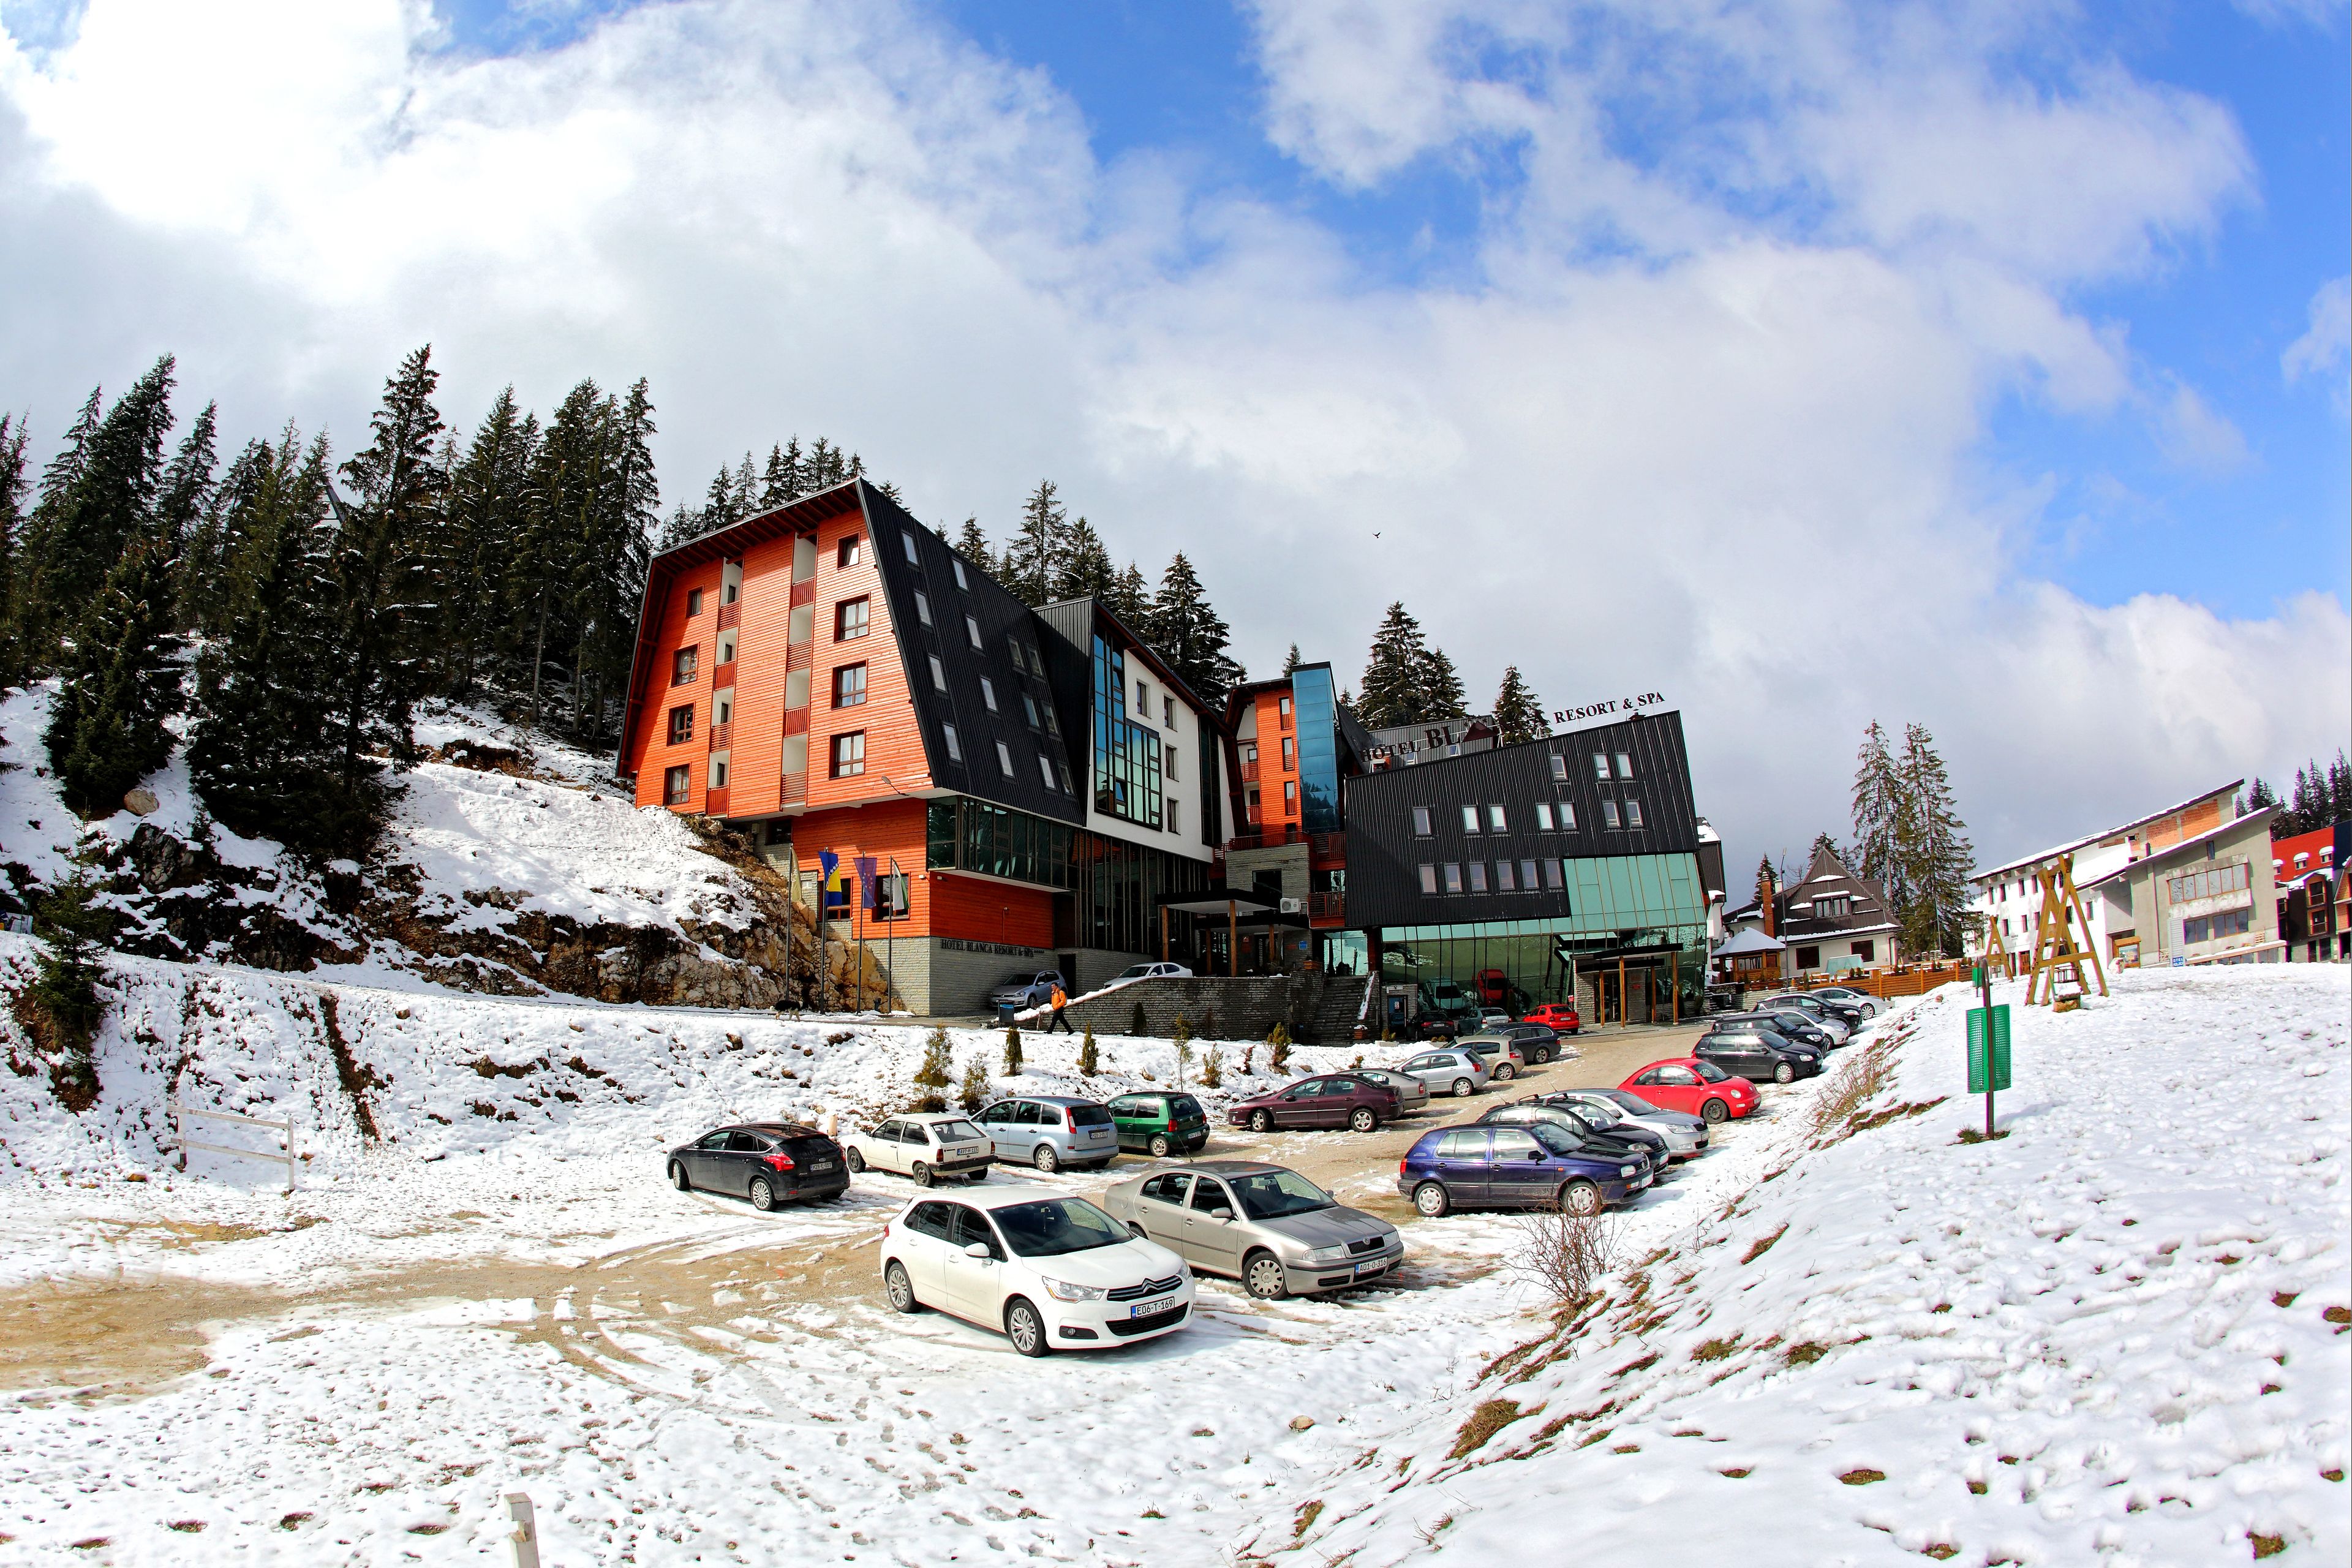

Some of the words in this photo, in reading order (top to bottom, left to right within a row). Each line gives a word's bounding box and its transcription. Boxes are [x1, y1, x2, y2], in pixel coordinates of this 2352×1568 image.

[1359, 740, 1421, 763] HOTEL
[1553, 700, 1616, 724] RESORT
[1623, 698, 1634, 709] &
[1637, 692, 1666, 706] SPA
[941, 938, 965, 951] HOTEL
[967, 941, 993, 954] BLANCA
[994, 944, 1018, 956] RESORT
[1024, 948, 1035, 957] SPA
[1137, 1298, 1173, 1316] E06-T-169
